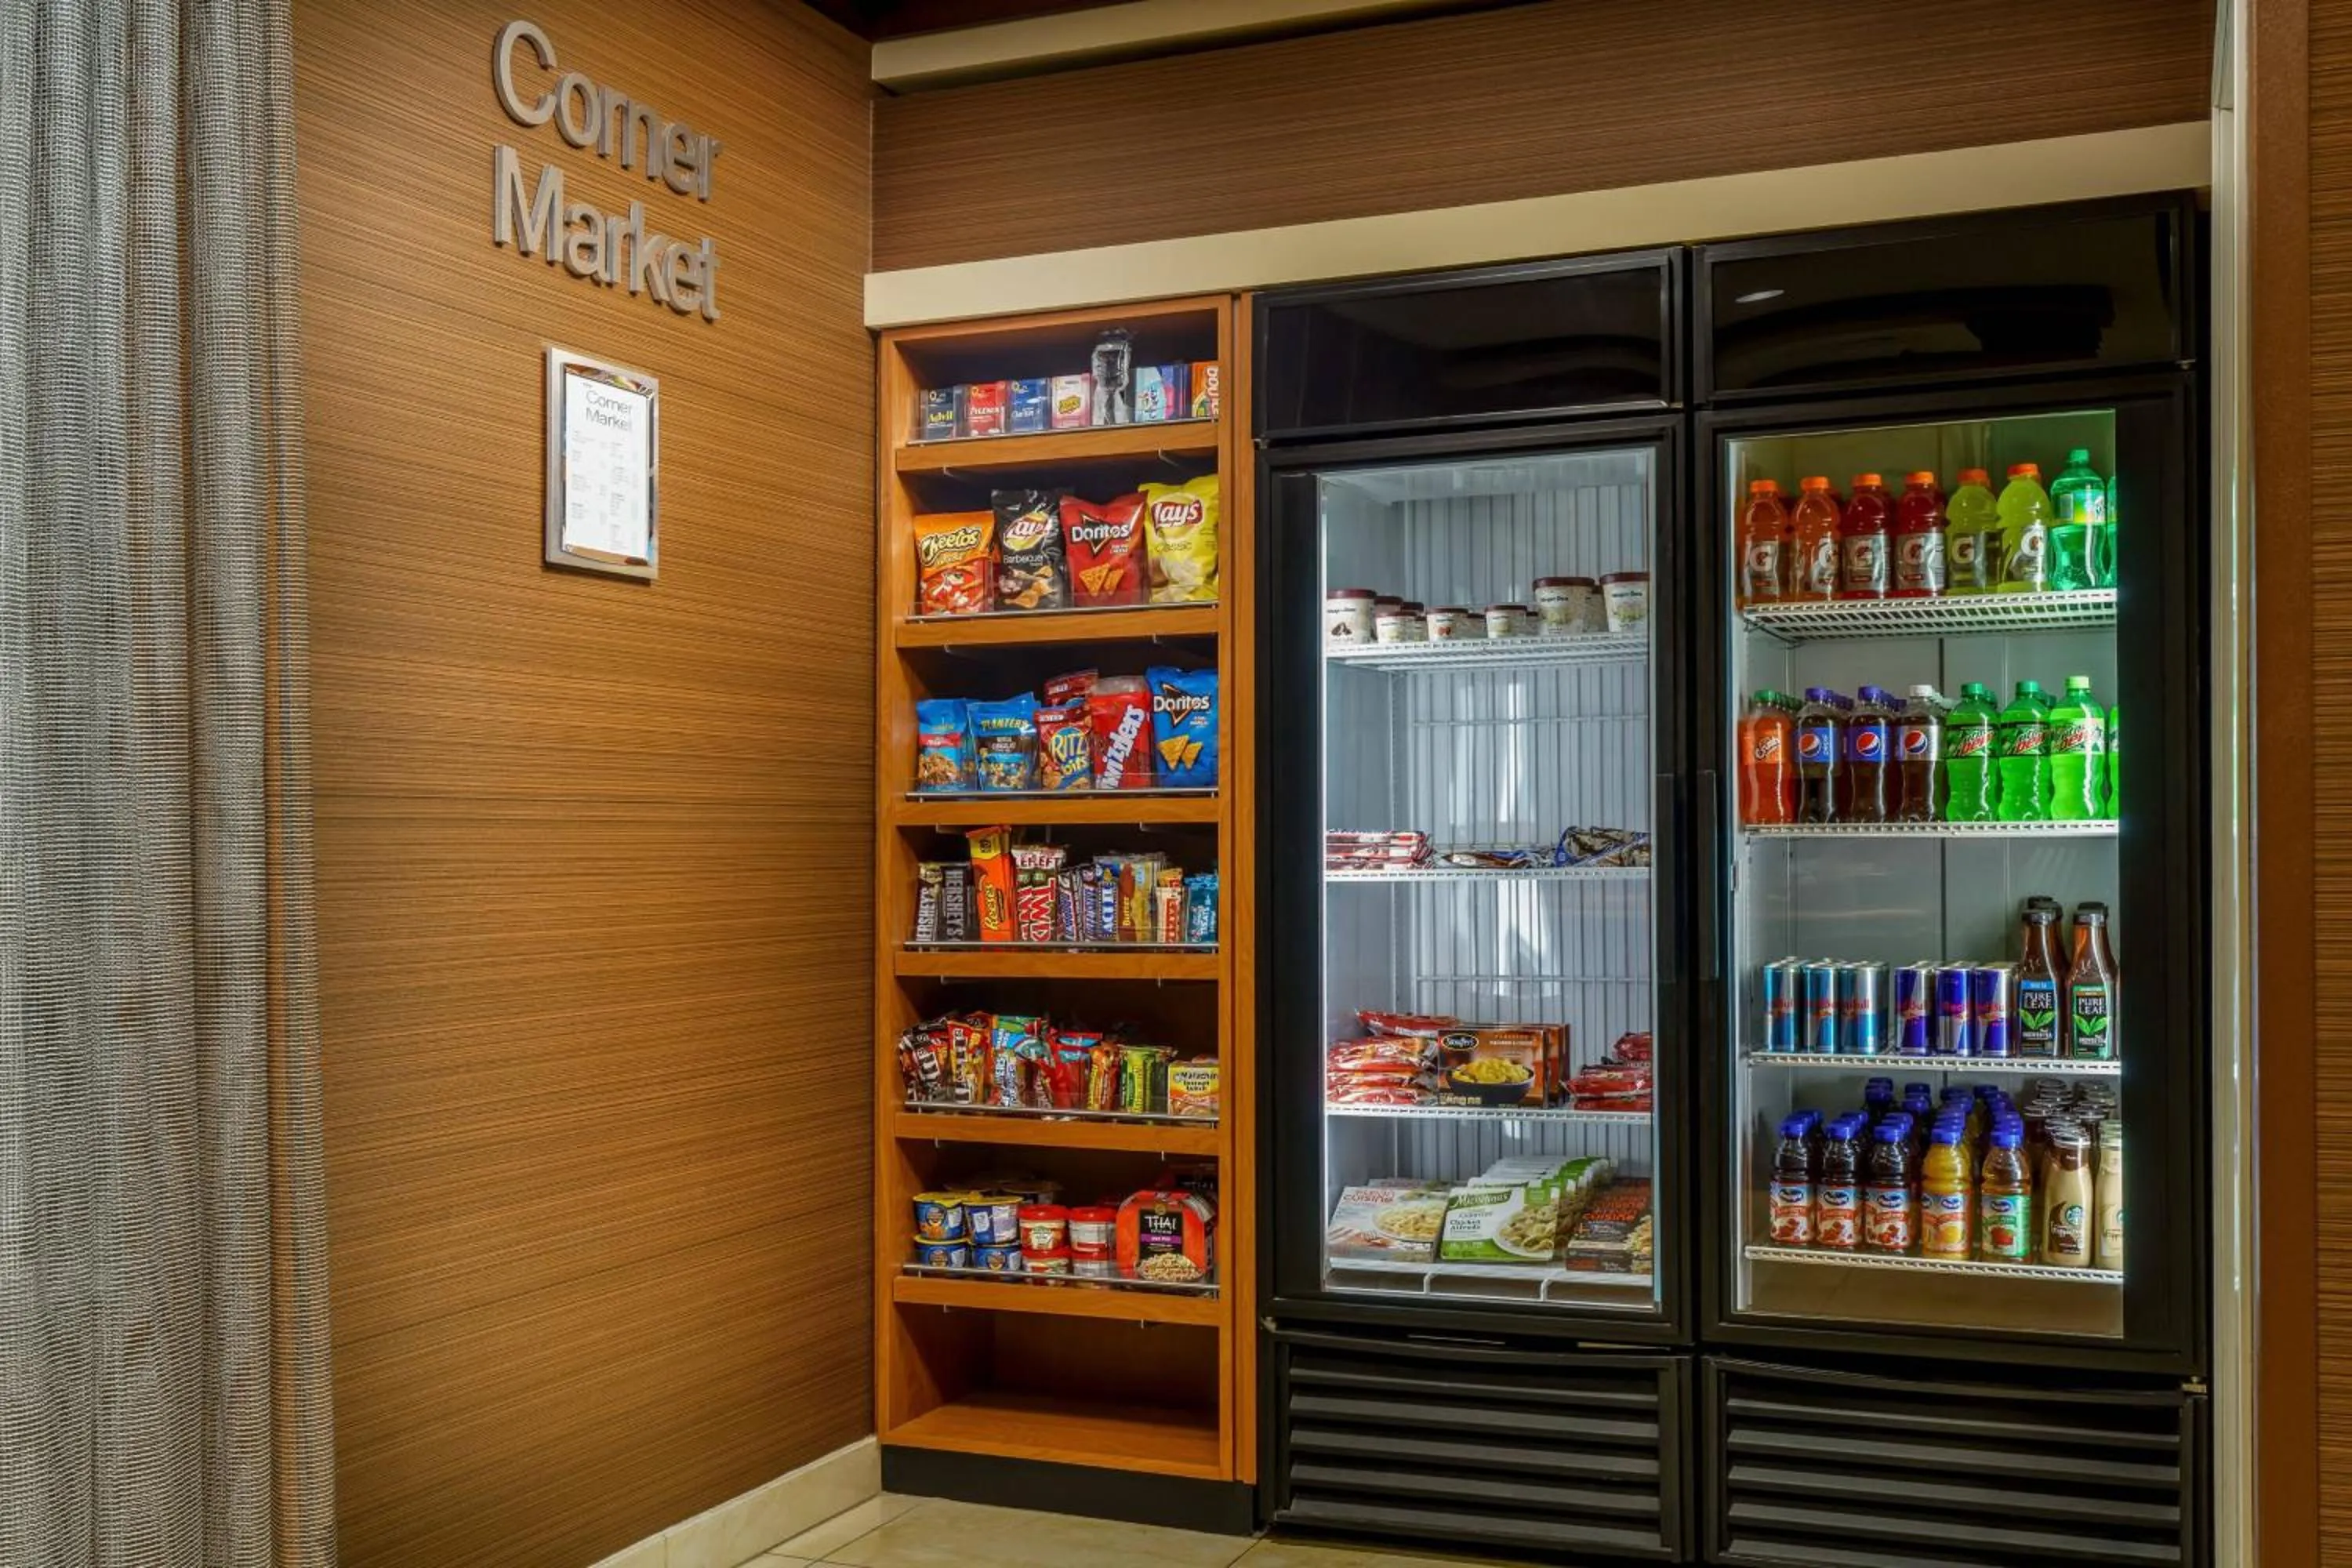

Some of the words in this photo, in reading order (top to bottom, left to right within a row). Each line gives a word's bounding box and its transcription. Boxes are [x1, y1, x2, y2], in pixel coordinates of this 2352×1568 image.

[493, 20, 723, 203] Corner
[493, 144, 721, 321] Market
[586, 390, 633, 416] Corner
[586, 408, 633, 432] Market
[928, 410, 954, 424] Advil
[1155, 499, 1202, 528] Lay's
[1072, 523, 1131, 543] Doritos
[920, 526, 982, 567] Cheetos
[1749, 544, 1773, 572] G
[1952, 536, 1975, 564] G
[1153, 695, 1210, 713] Doritos
[1051, 733, 1089, 764] RITZ
[945, 869, 964, 936] HERSHEY'S
[2024, 991, 2053, 1000] PURE
[2024, 999, 2053, 1009] LEAF
[2078, 1004, 2107, 1014] LEAF
[1144, 1214, 1177, 1230] THAI
